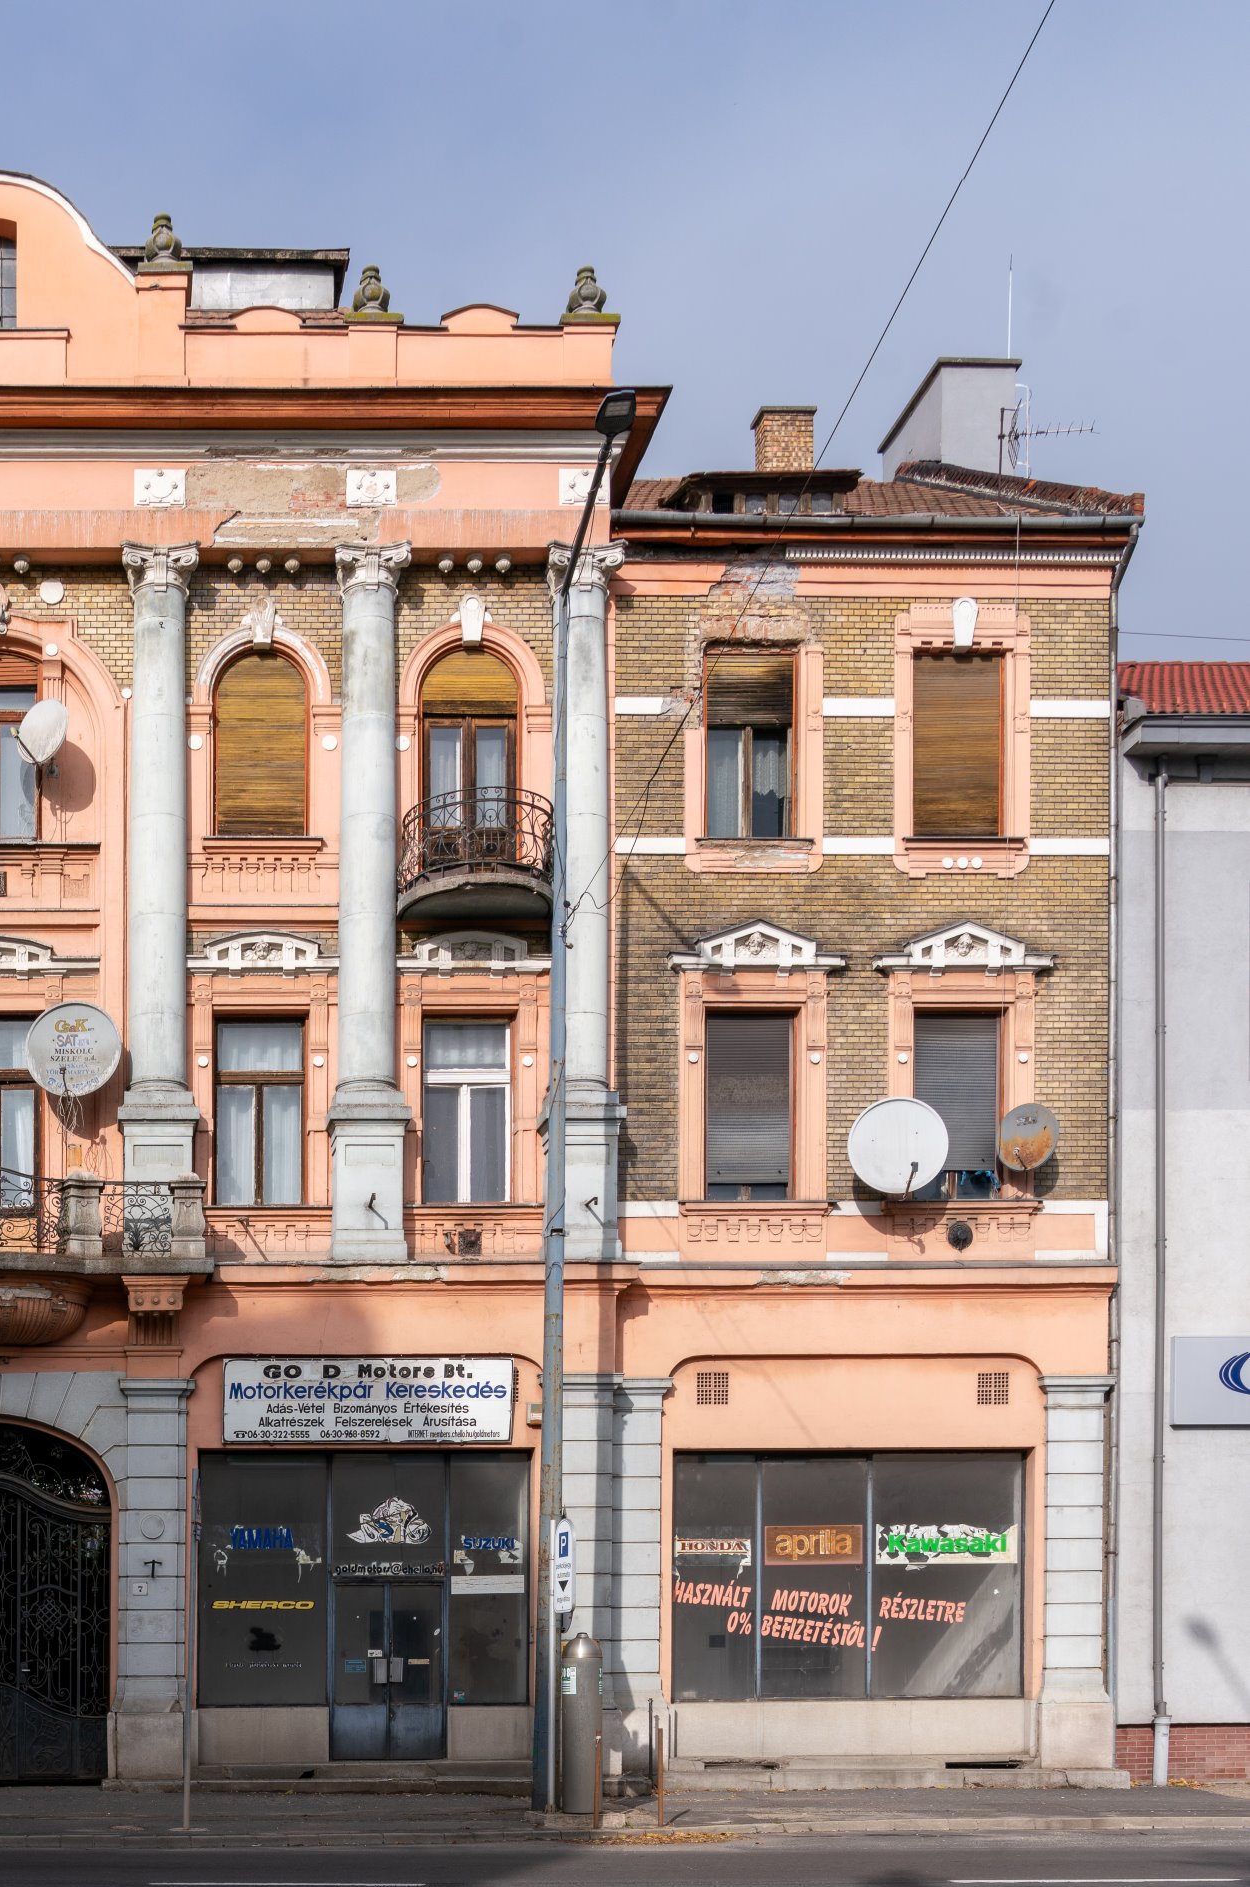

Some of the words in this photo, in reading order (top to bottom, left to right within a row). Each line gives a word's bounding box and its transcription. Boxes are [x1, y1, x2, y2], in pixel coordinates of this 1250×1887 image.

[56, 1034, 78, 1047] SAT
[357, 1363, 436, 1379] Motors
[443, 1363, 473, 1379] Bt.
[229, 1380, 374, 1402] Motorkerékpár
[385, 1380, 508, 1400] Kereskedés
[266, 1402, 325, 1414] Adás-Vétel
[403, 1400, 470, 1414] Értékesítés
[258, 1416, 325, 1428] Alkatrészek
[334, 1415, 413, 1428] Felszerelések
[422, 1413, 478, 1428] Árusítása
[230, 1527, 295, 1550] YAMAHA
[463, 1537, 515, 1550] SUZUKI
[680, 1541, 746, 1552] HONDA
[775, 1529, 853, 1561] aprilia
[887, 1533, 1007, 1554] Kawasaki
[211, 1599, 316, 1610] SHERCO
[674, 1579, 752, 1608] HASZNÁLT
[770, 1589, 853, 1618] MOTOROK
[878, 1592, 967, 1624] RÉSZLETRE
[726, 1611, 752, 1635] 0%
